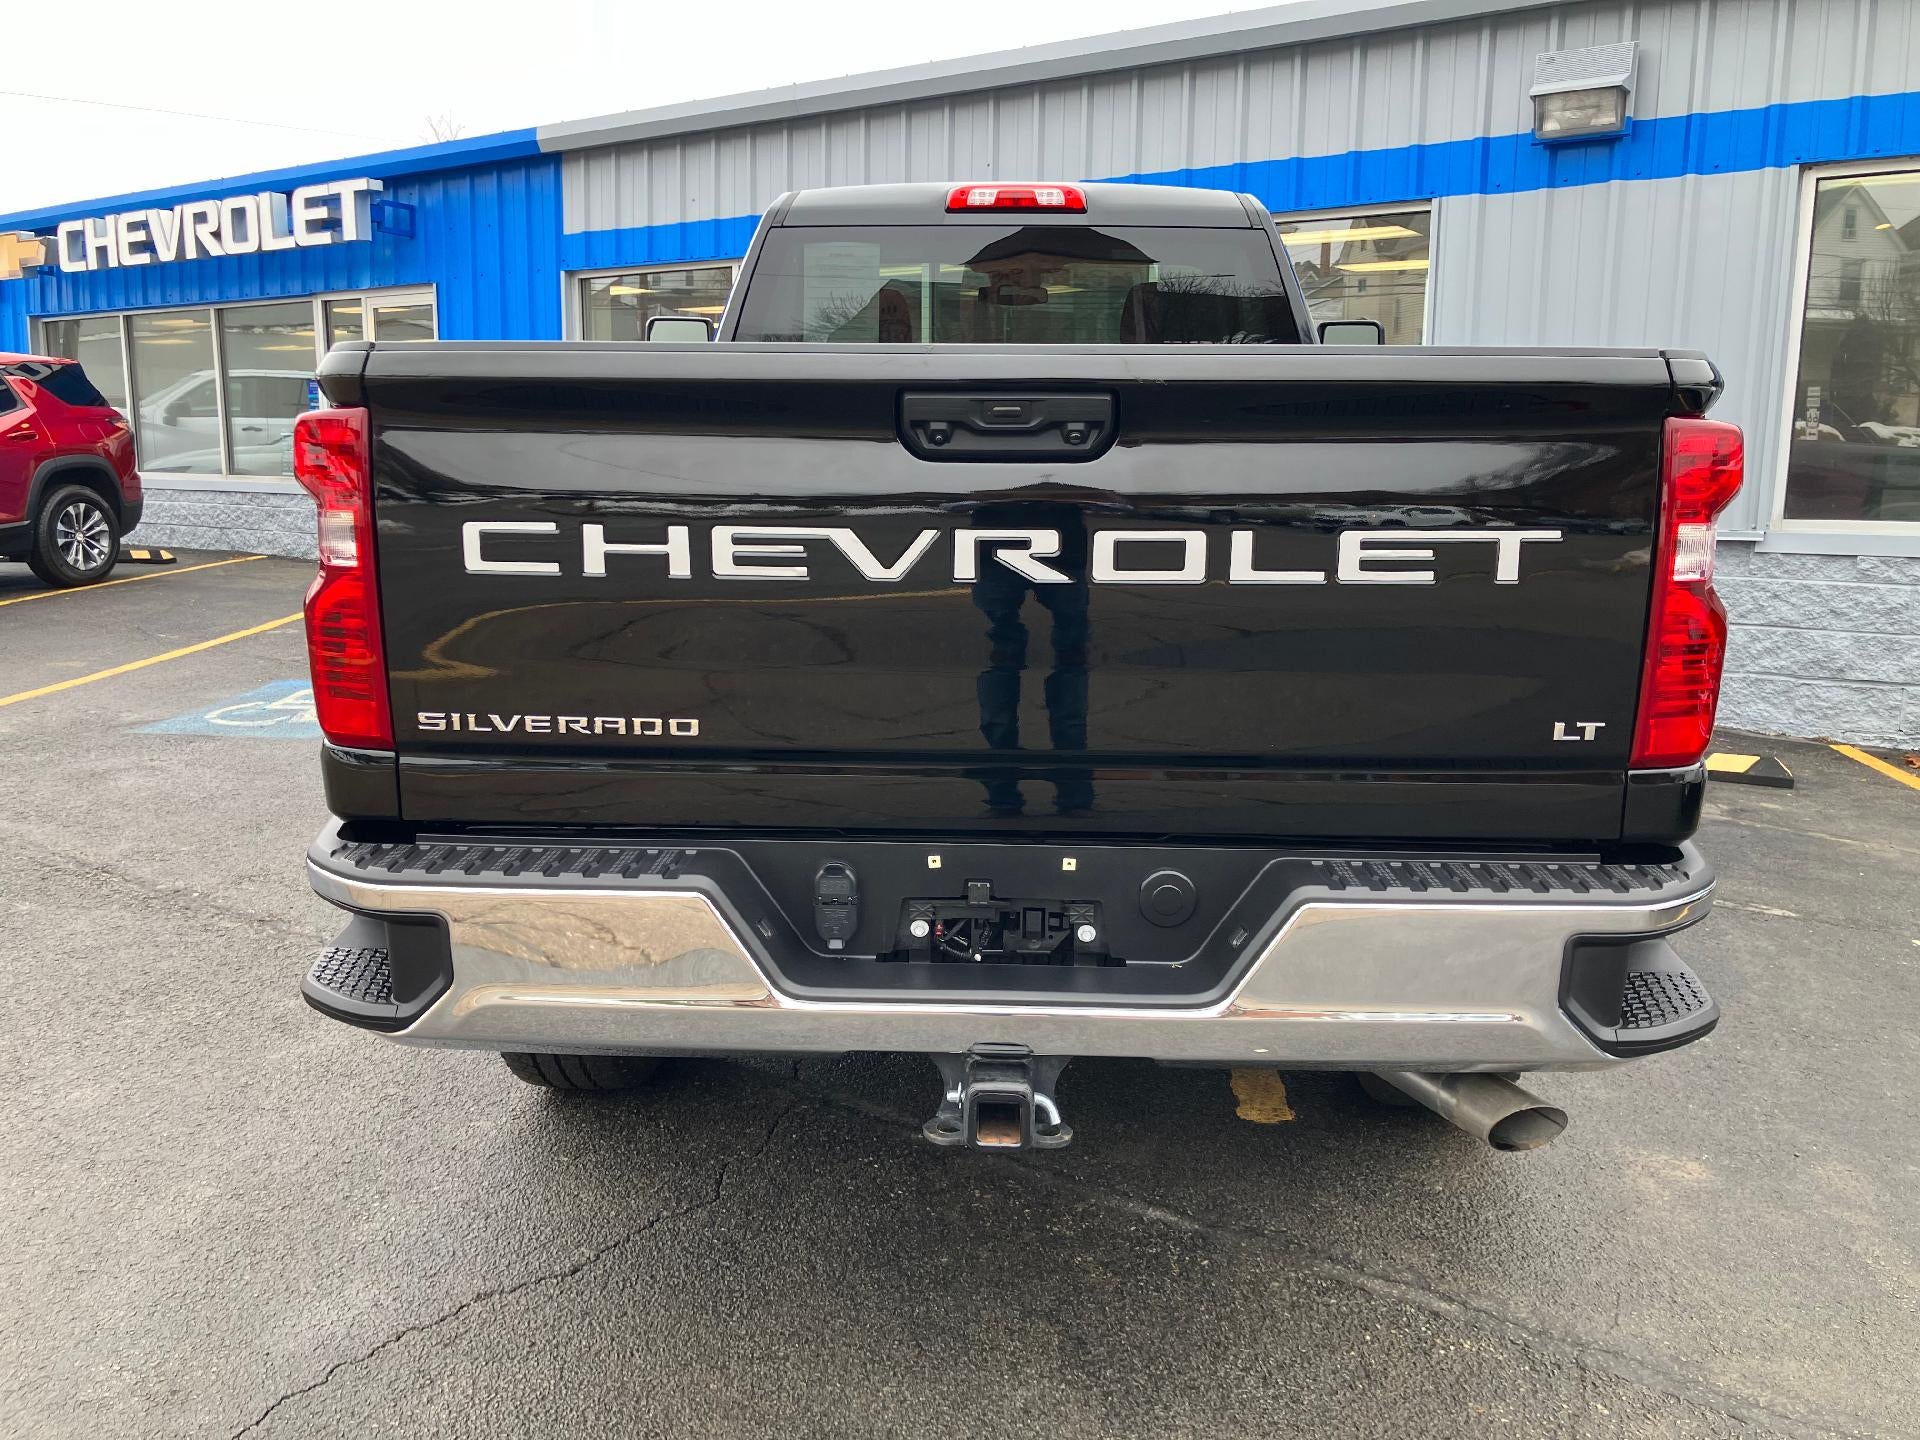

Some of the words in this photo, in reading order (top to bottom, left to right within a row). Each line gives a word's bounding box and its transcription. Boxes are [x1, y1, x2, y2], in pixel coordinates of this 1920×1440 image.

[57, 178, 379, 273] CHEVROLET
[462, 521, 1563, 584] CHEVROLET
[417, 711, 700, 737] SILVERADO
[1552, 721, 1606, 741] LT
